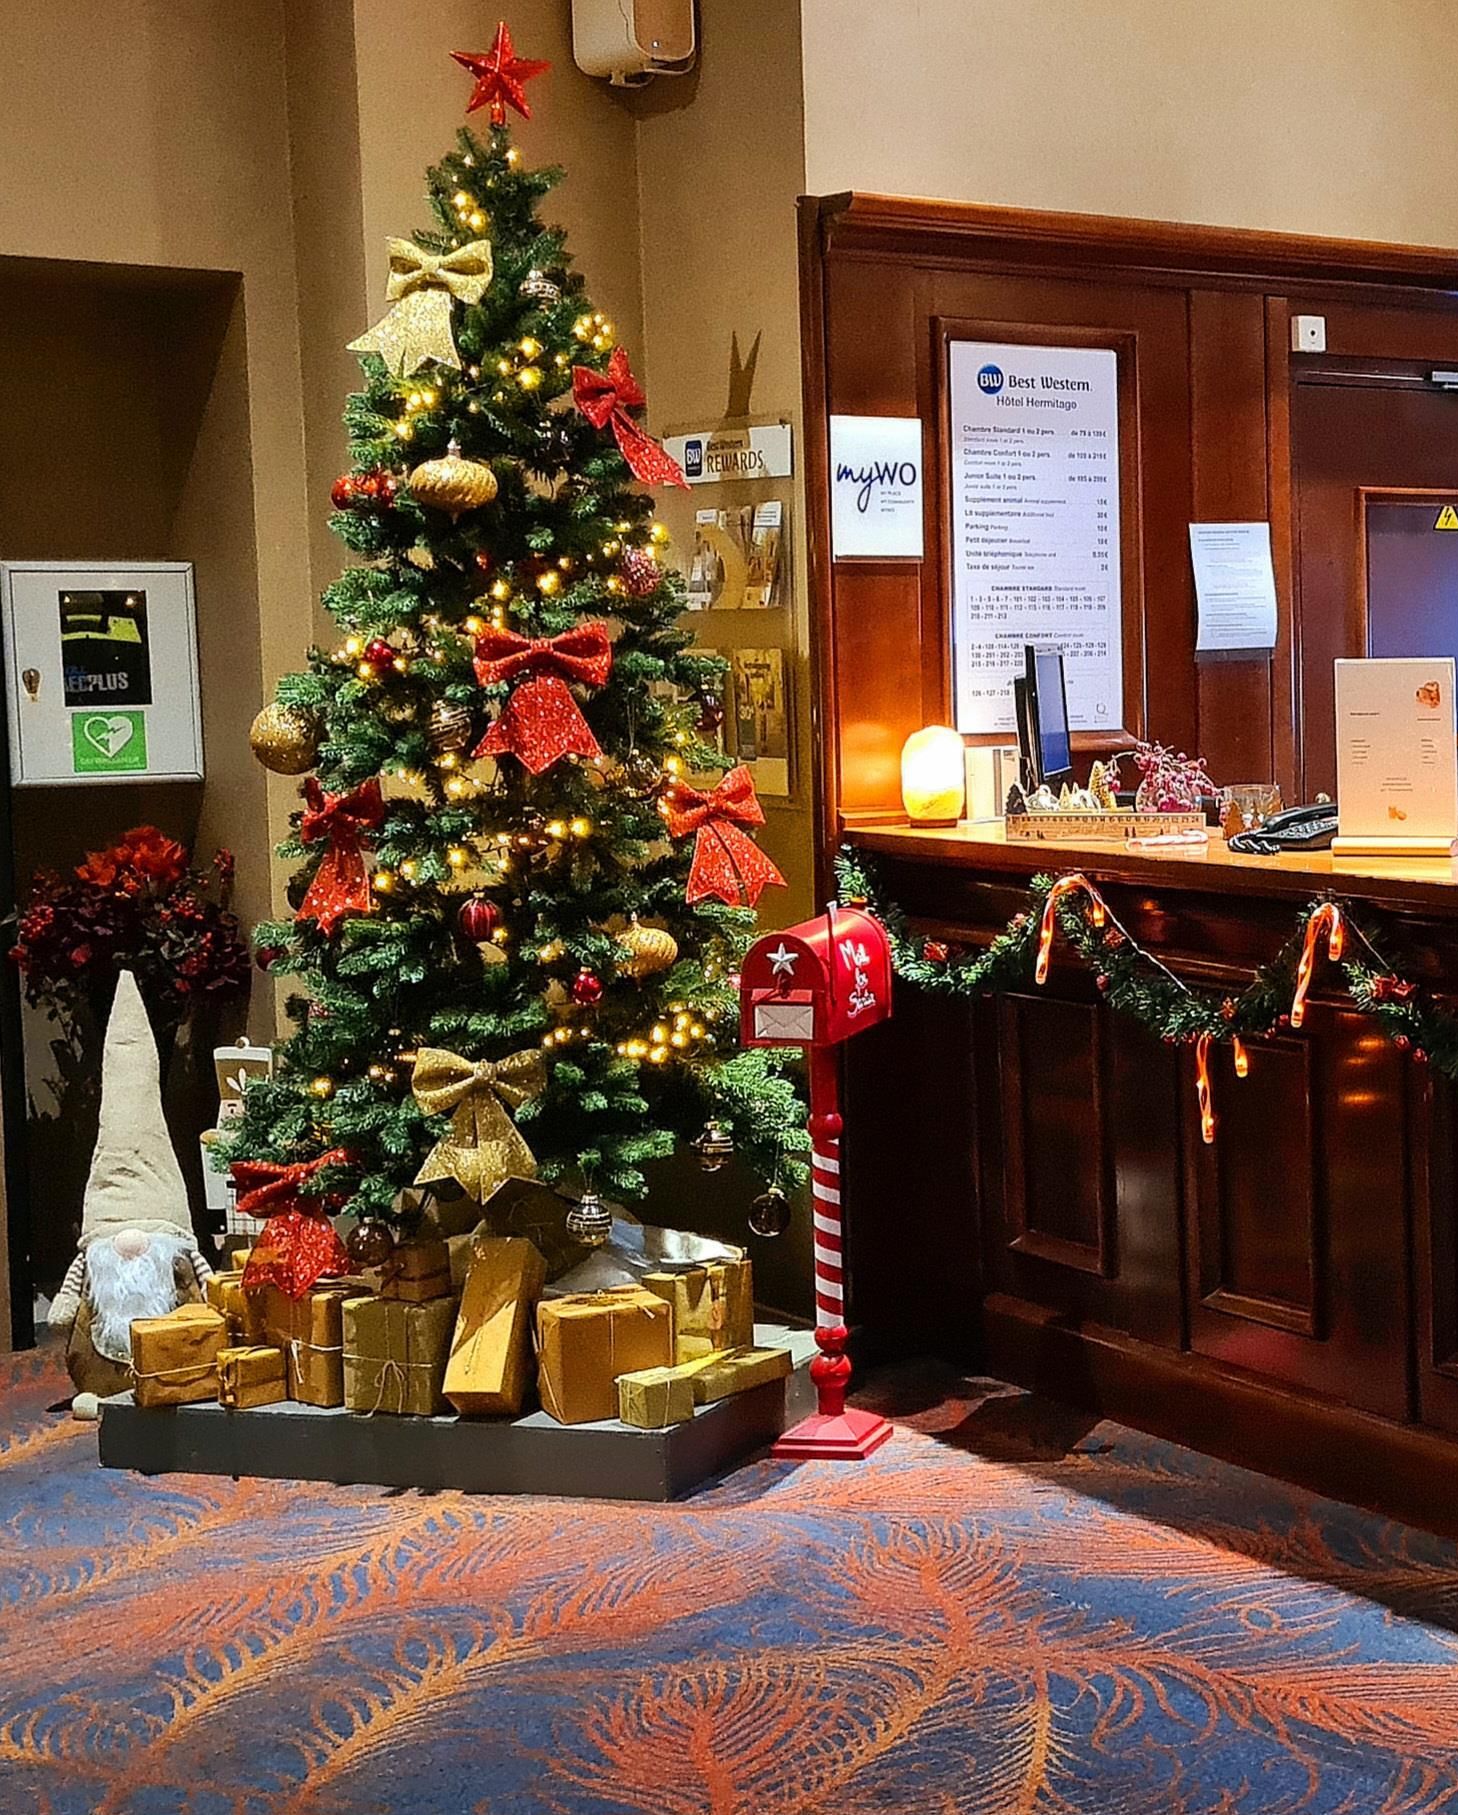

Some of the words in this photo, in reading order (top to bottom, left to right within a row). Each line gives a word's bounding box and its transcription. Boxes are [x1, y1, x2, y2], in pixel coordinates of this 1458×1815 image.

[1008, 375, 1036, 389] Best
[1040, 376, 1090, 391] Western
[996, 395, 1024, 407] Hôtel
[1026, 397, 1077, 411] Hermitage
[706, 449, 764, 473] REWARDS
